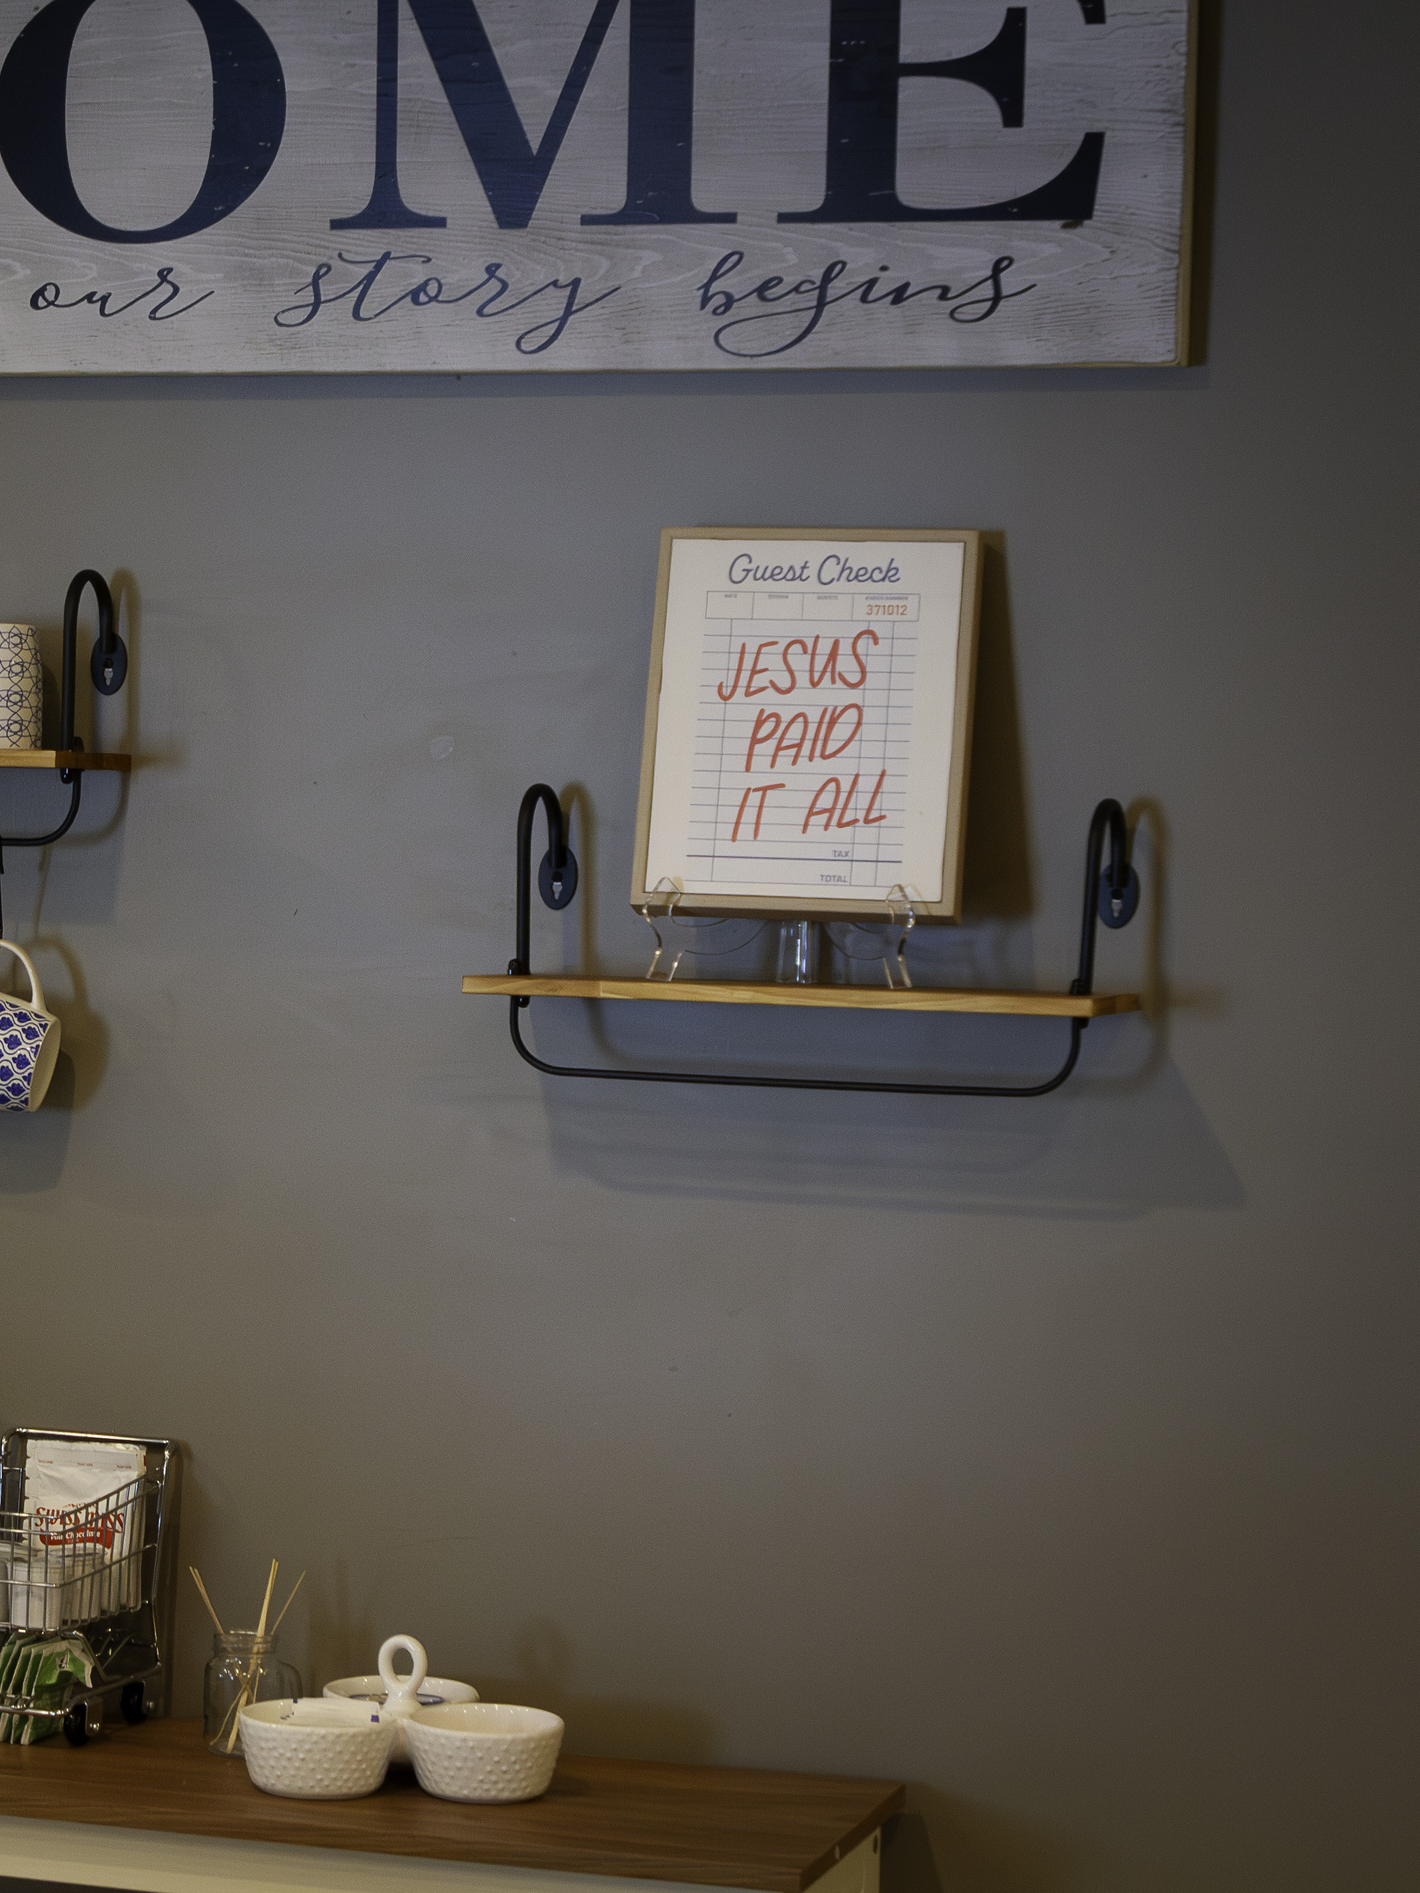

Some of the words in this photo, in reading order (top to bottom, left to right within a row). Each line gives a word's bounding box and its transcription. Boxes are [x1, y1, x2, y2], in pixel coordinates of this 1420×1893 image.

[29, 267, 215, 321] our
[274, 250, 622, 355] story
[696, 250, 1038, 359] begins
[728, 553, 811, 585] Guest
[816, 554, 901, 586] Check
[866, 603, 908, 616] 371012
[717, 629, 880, 702] JESUS
[745, 703, 863, 773] PAID
[731, 783, 786, 842] IT
[802, 769, 887, 834] ALL
[820, 874, 848, 883] TOTAL
[833, 850, 850, 858] TAX
